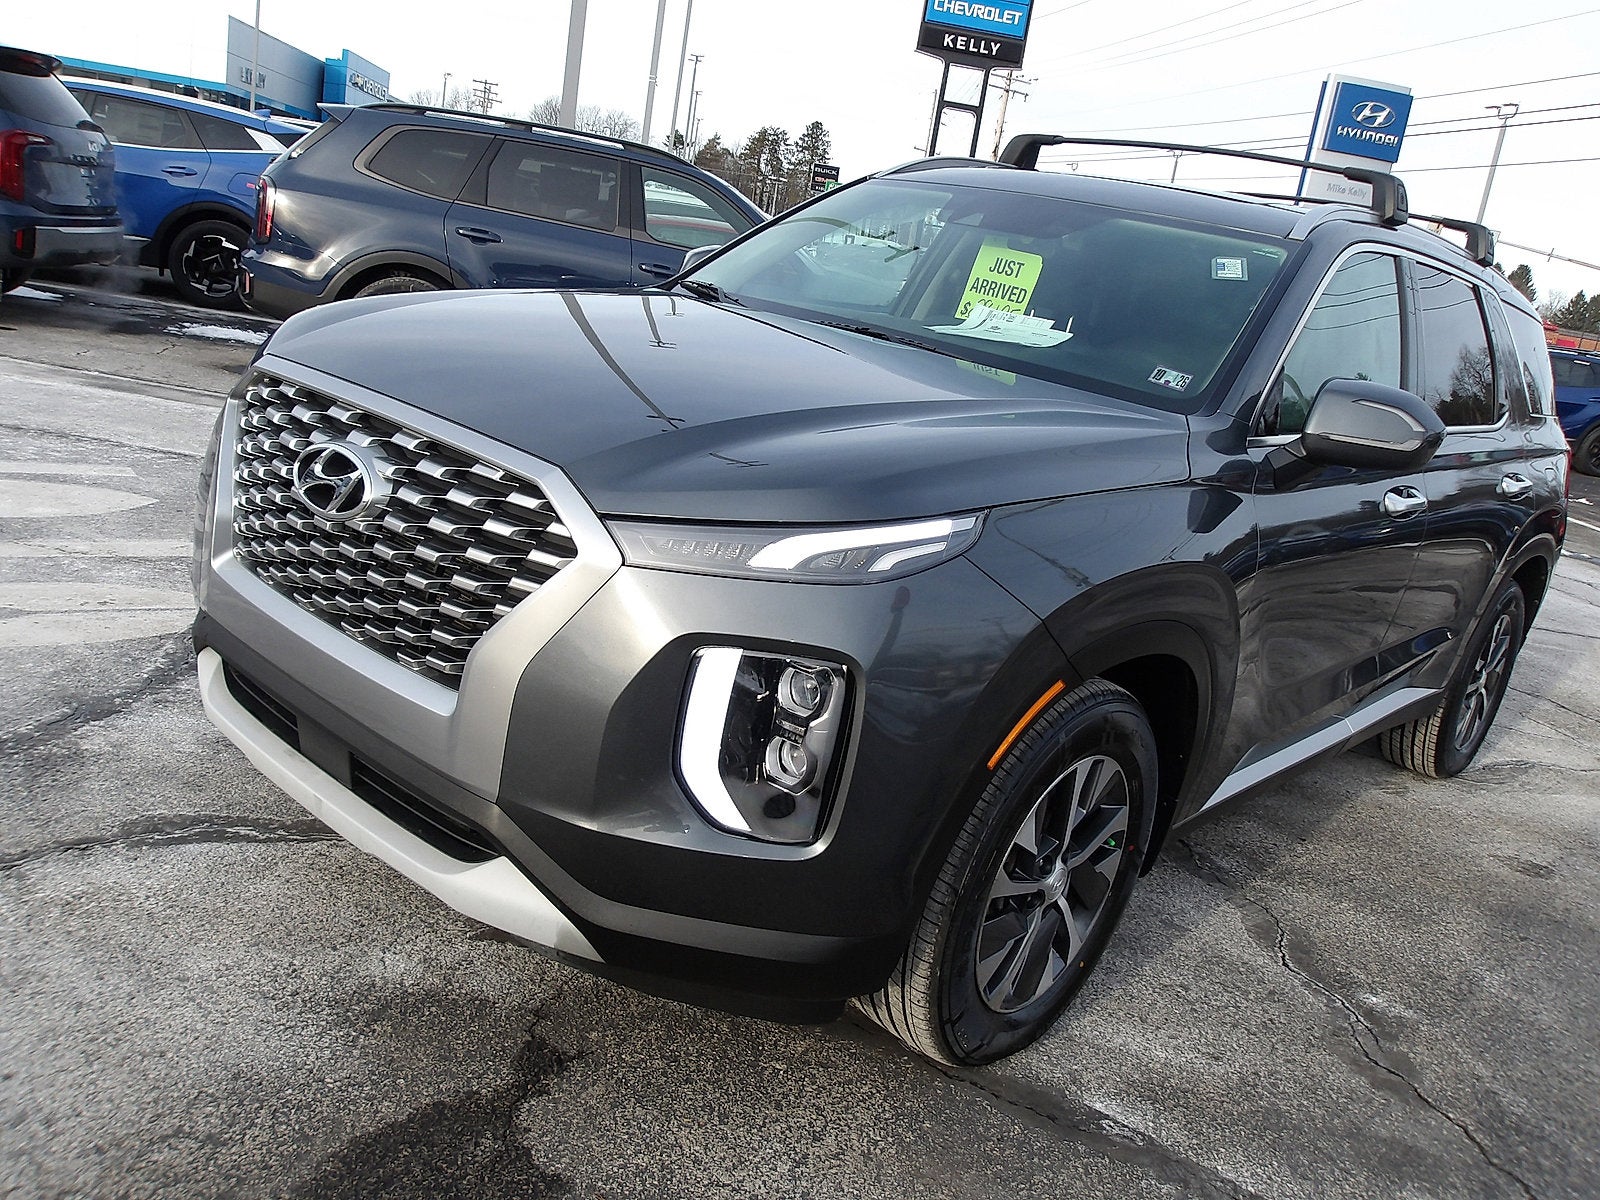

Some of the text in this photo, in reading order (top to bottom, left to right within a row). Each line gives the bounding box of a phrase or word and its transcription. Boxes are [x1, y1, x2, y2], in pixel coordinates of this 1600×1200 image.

[933, 0, 1023, 25] CHEVROLET
[943, 33, 1001, 56] KELLY
[1336, 125, 1399, 147] HYUNDAI
[1326, 182, 1346, 195] Mike
[988, 257, 1025, 278] JUST
[969, 276, 1028, 304] ARRIVED
